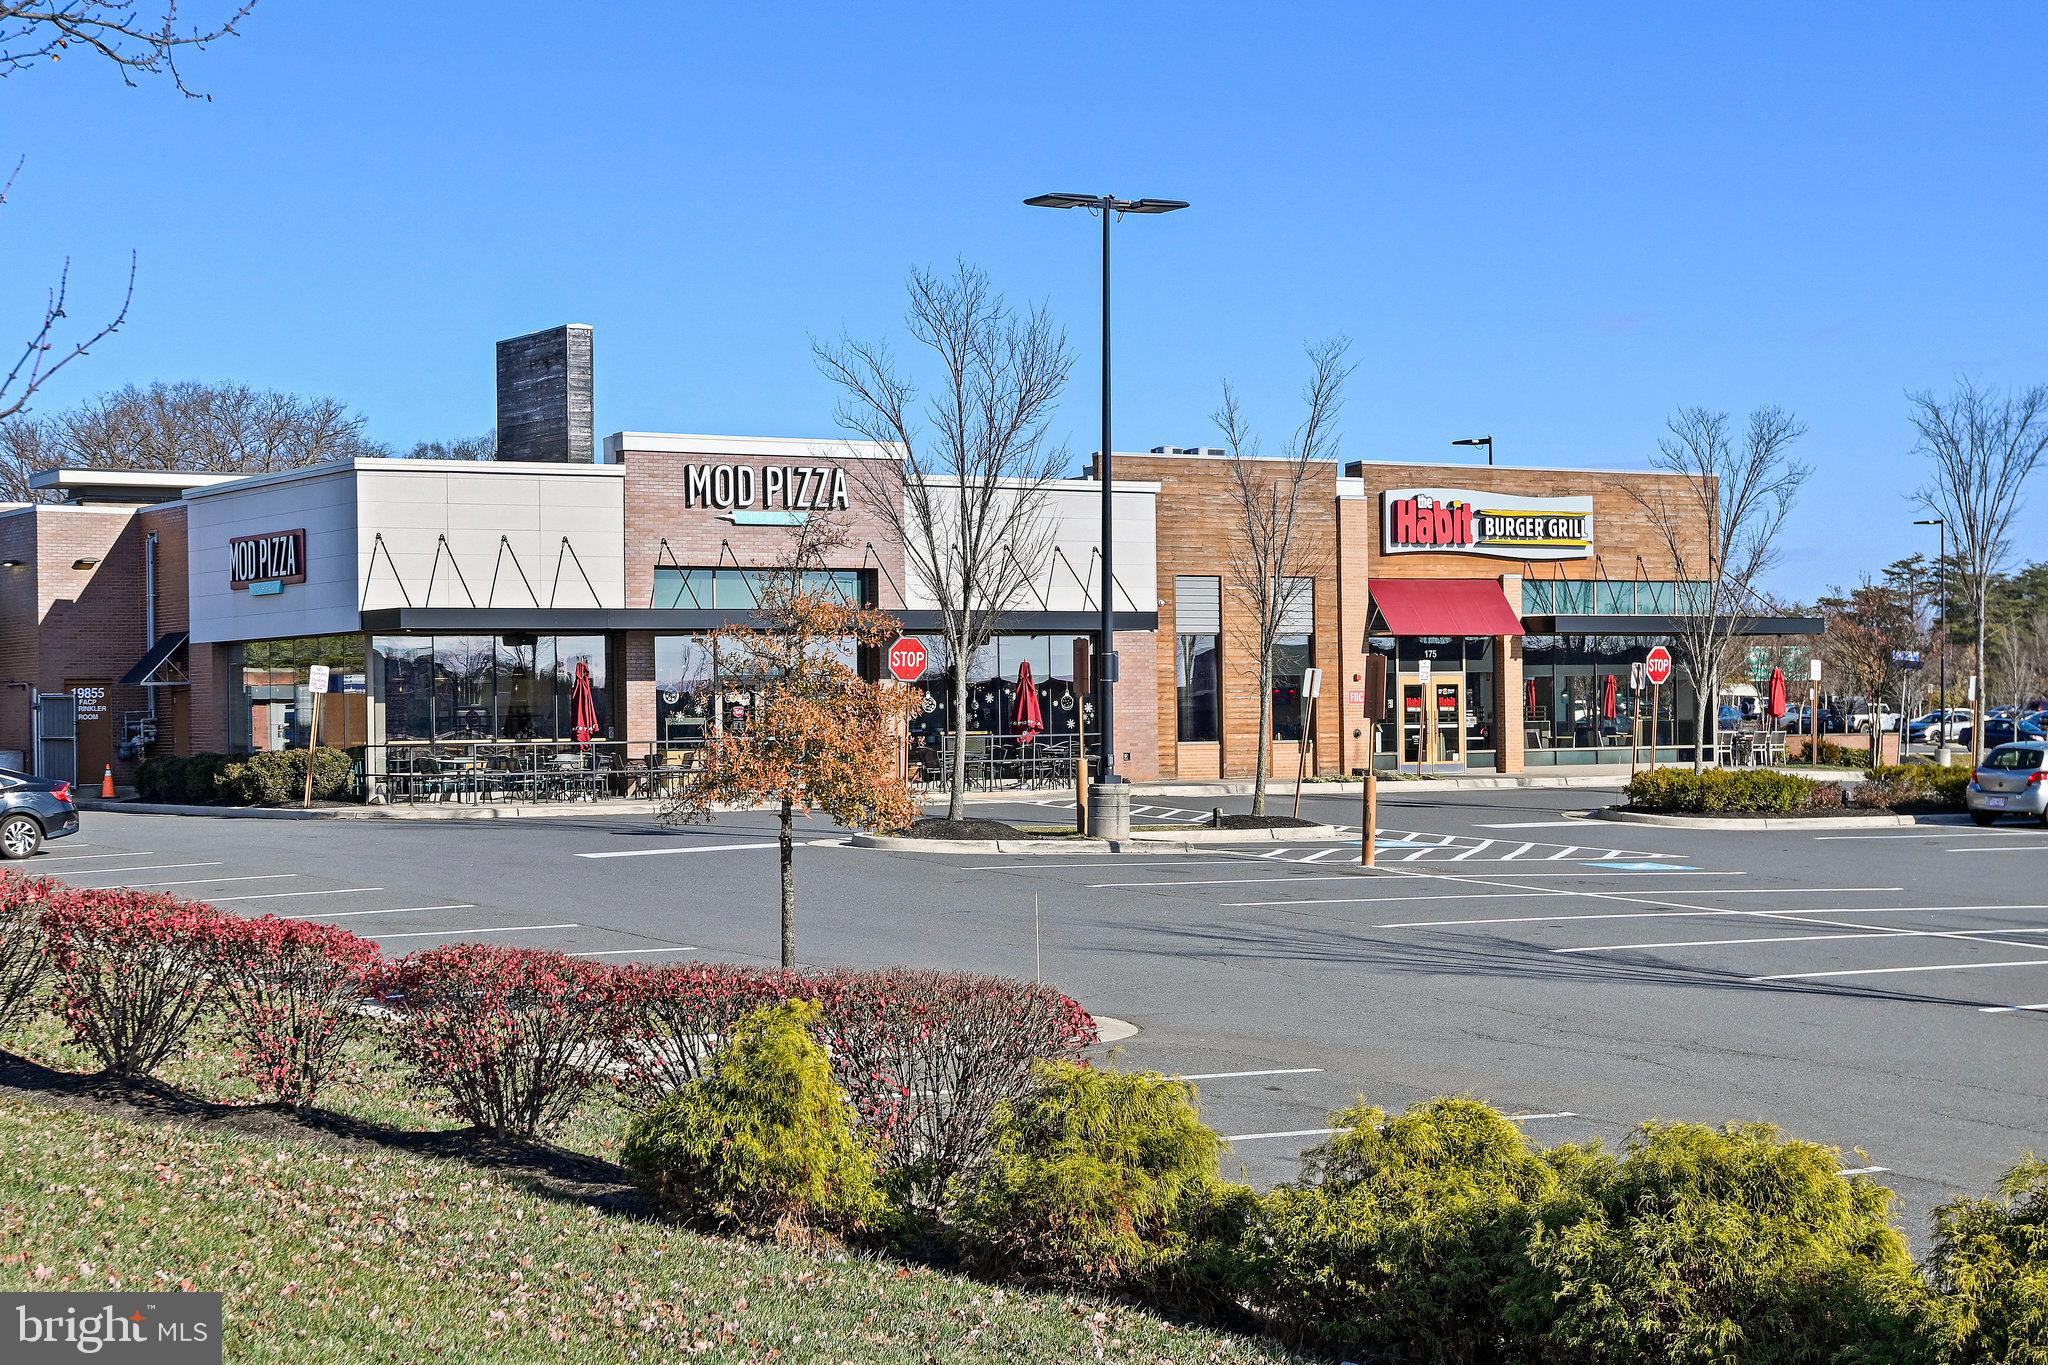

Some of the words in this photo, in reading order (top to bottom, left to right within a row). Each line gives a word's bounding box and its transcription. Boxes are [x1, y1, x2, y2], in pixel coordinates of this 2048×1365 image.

[686, 464, 755, 508] MOD
[763, 466, 850, 510] PIZZA
[1417, 494, 1433, 509] the
[1395, 499, 1472, 544] Habit
[1485, 517, 1544, 538] BURGER
[1548, 518, 1588, 538] GRILL
[230, 541, 256, 581] MOD
[260, 535, 296, 578] PIZZA
[892, 650, 924, 667] STOP
[1424, 649, 1437, 658] 175
[1648, 658, 1669, 672] STOP
[71, 688, 105, 699] 19855
[1350, 692, 1364, 702] FDC
